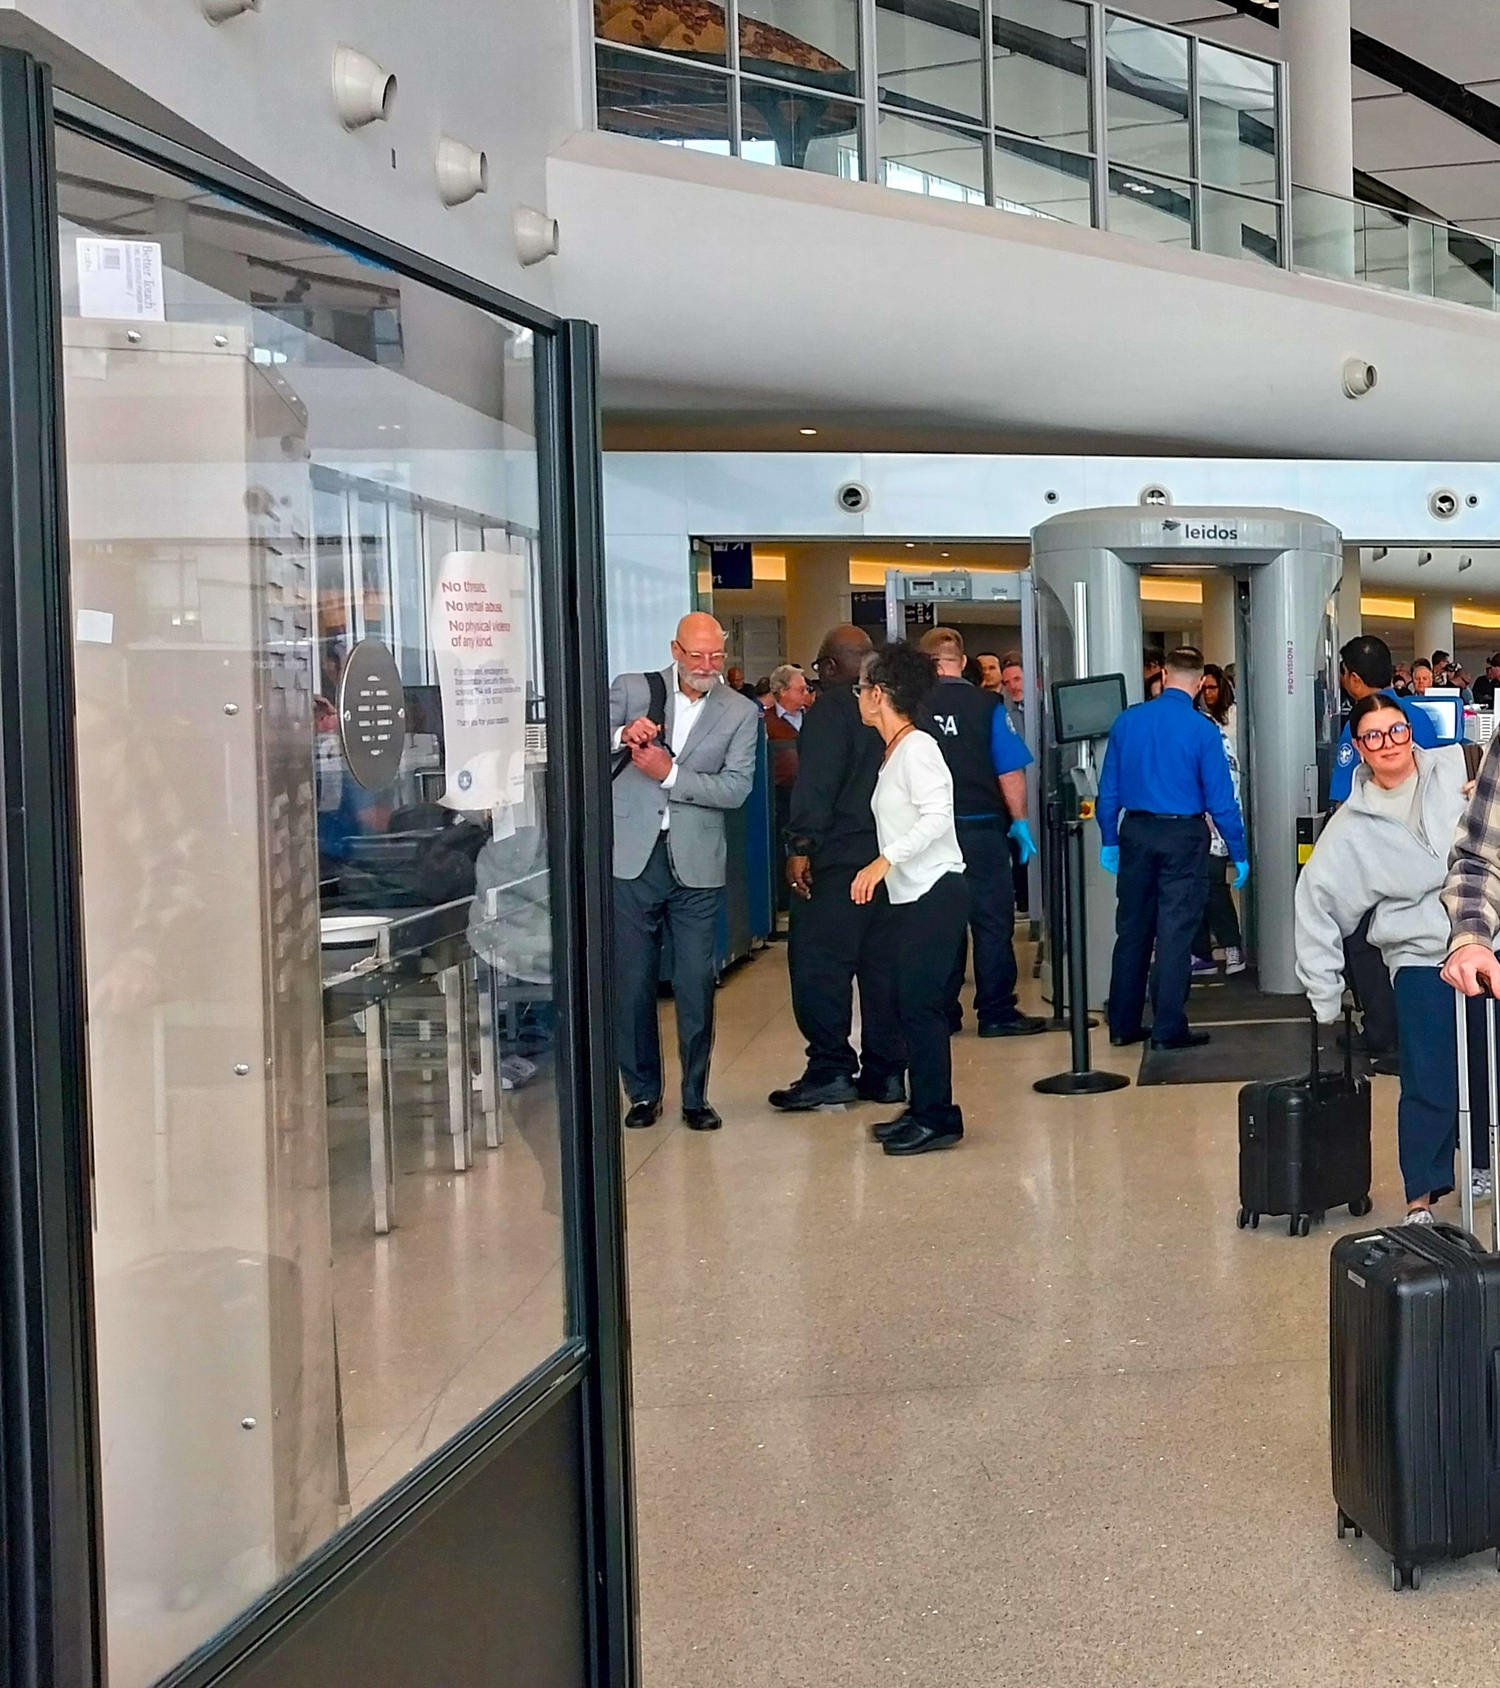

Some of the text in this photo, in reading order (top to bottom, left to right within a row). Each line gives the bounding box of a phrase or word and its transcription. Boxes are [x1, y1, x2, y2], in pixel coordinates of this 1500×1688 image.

[143, 245, 156, 309] Better Touch
[1185, 523, 1237, 540] leidos
[441, 581, 461, 593] No
[445, 600, 463, 612] No
[449, 620, 464, 632] No
[451, 635, 461, 647] of
[463, 637, 474, 649] any
[933, 715, 959, 735] SA
